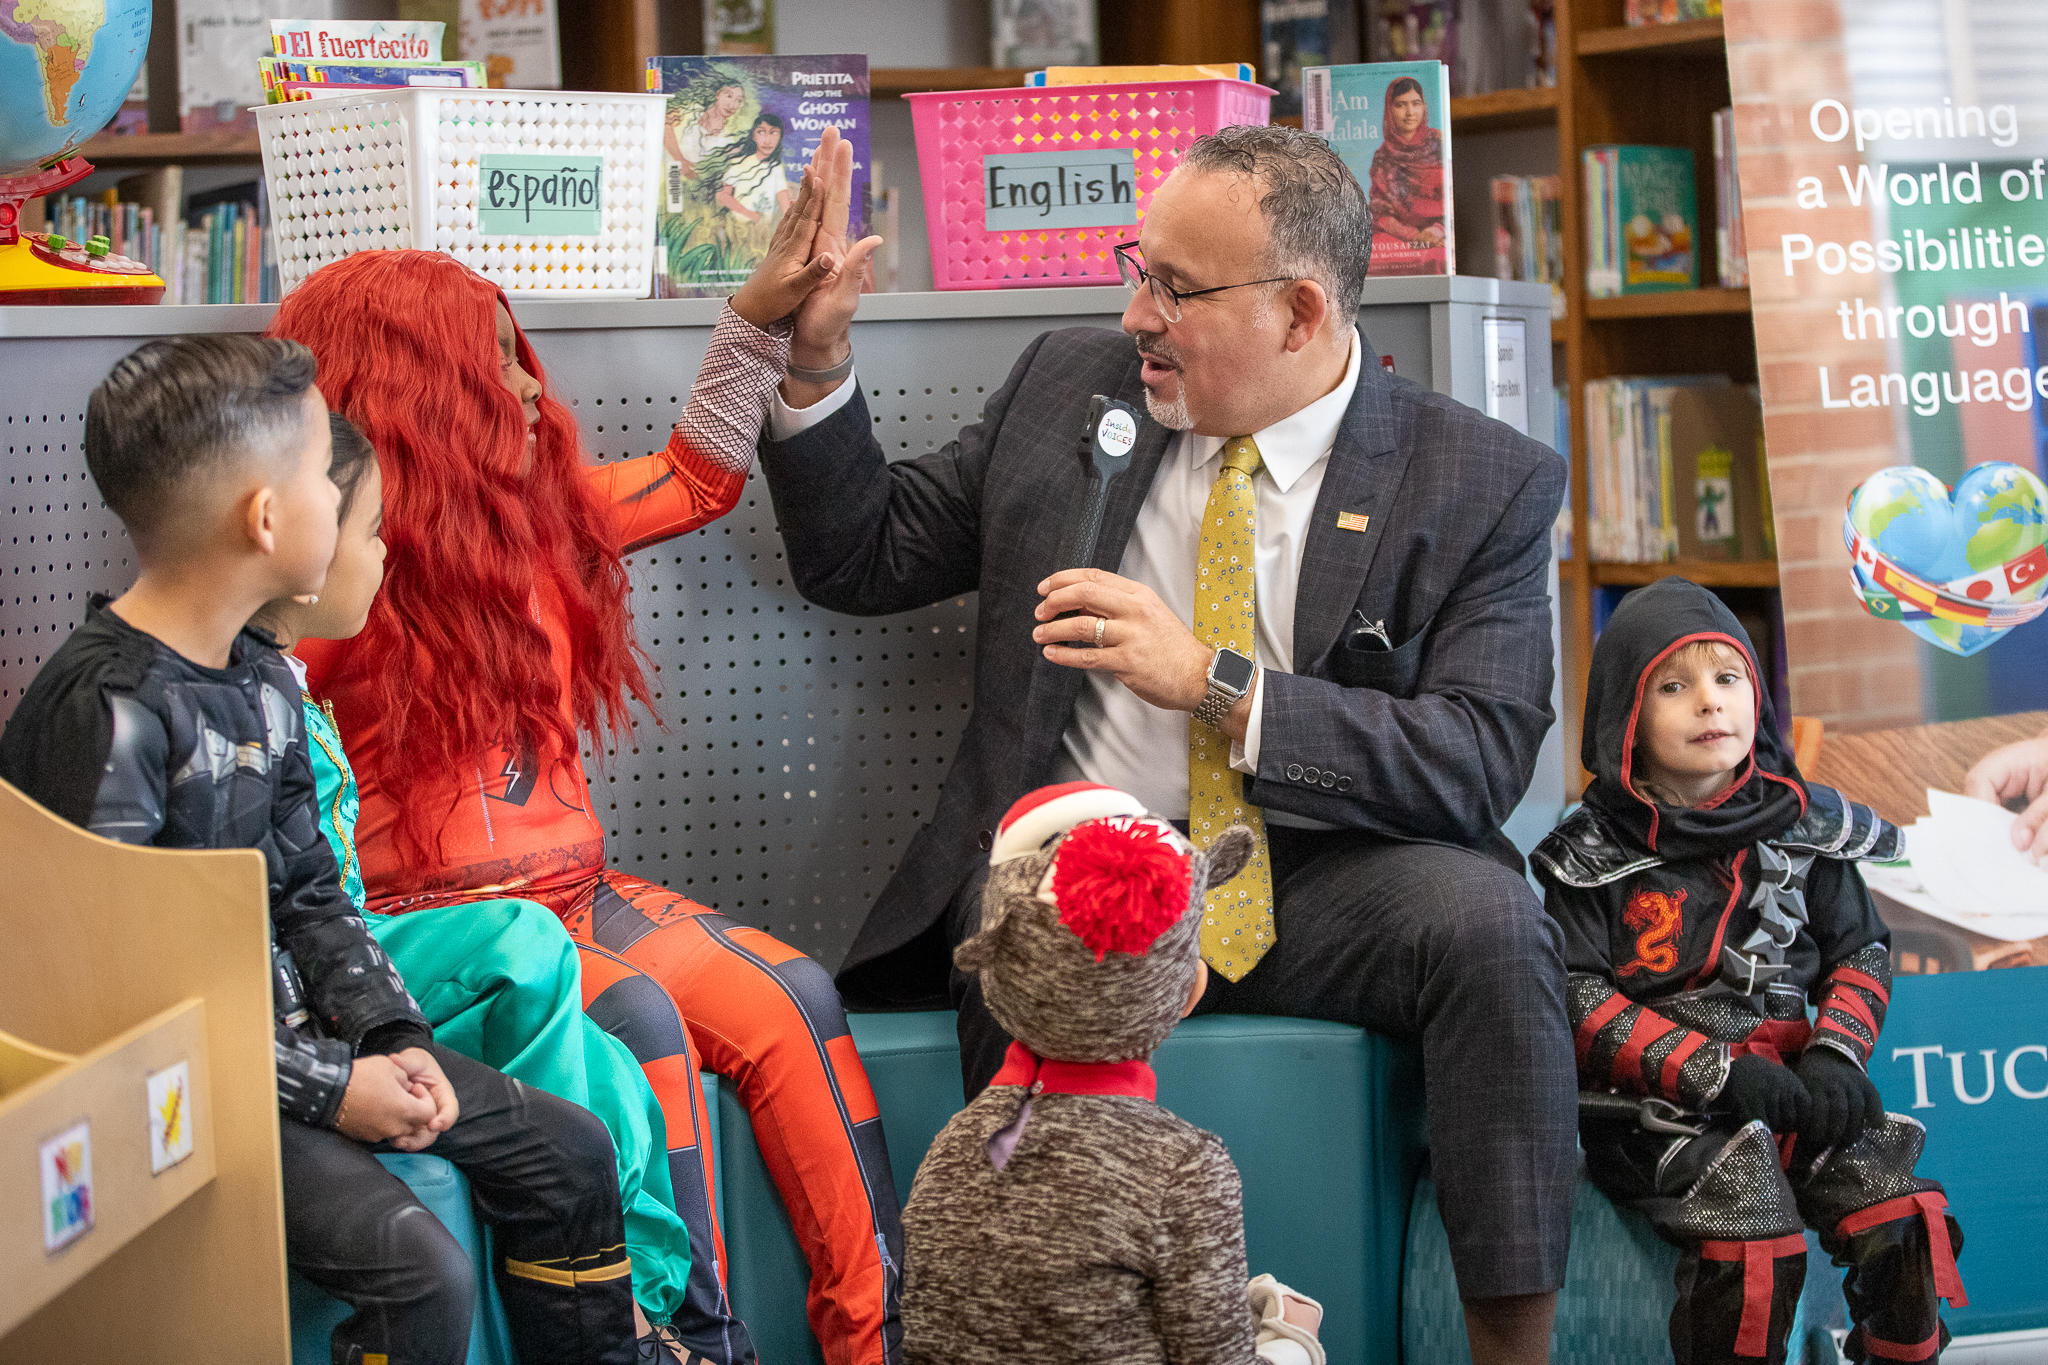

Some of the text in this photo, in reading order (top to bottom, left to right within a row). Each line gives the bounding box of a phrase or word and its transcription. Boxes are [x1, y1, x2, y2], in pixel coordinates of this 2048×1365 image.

[288, 31, 429, 59] El fuertecito
[791, 71, 855, 86] PRIETITA
[798, 101, 849, 115] GHOST
[803, 90, 843, 98] AND THE
[1334, 90, 1369, 111] Am
[790, 117, 857, 131] WOMAN
[1810, 97, 2018, 152] Opening
[487, 165, 600, 223] español
[989, 163, 1131, 217] English
[1797, 158, 2046, 209] a World of
[1781, 226, 2048, 276] Possibilitie
[1837, 292, 2030, 347] through
[1102, 428, 1133, 446] VOICES
[1105, 418, 1133, 435] Inside
[1892, 1044, 2048, 1109] TUC
